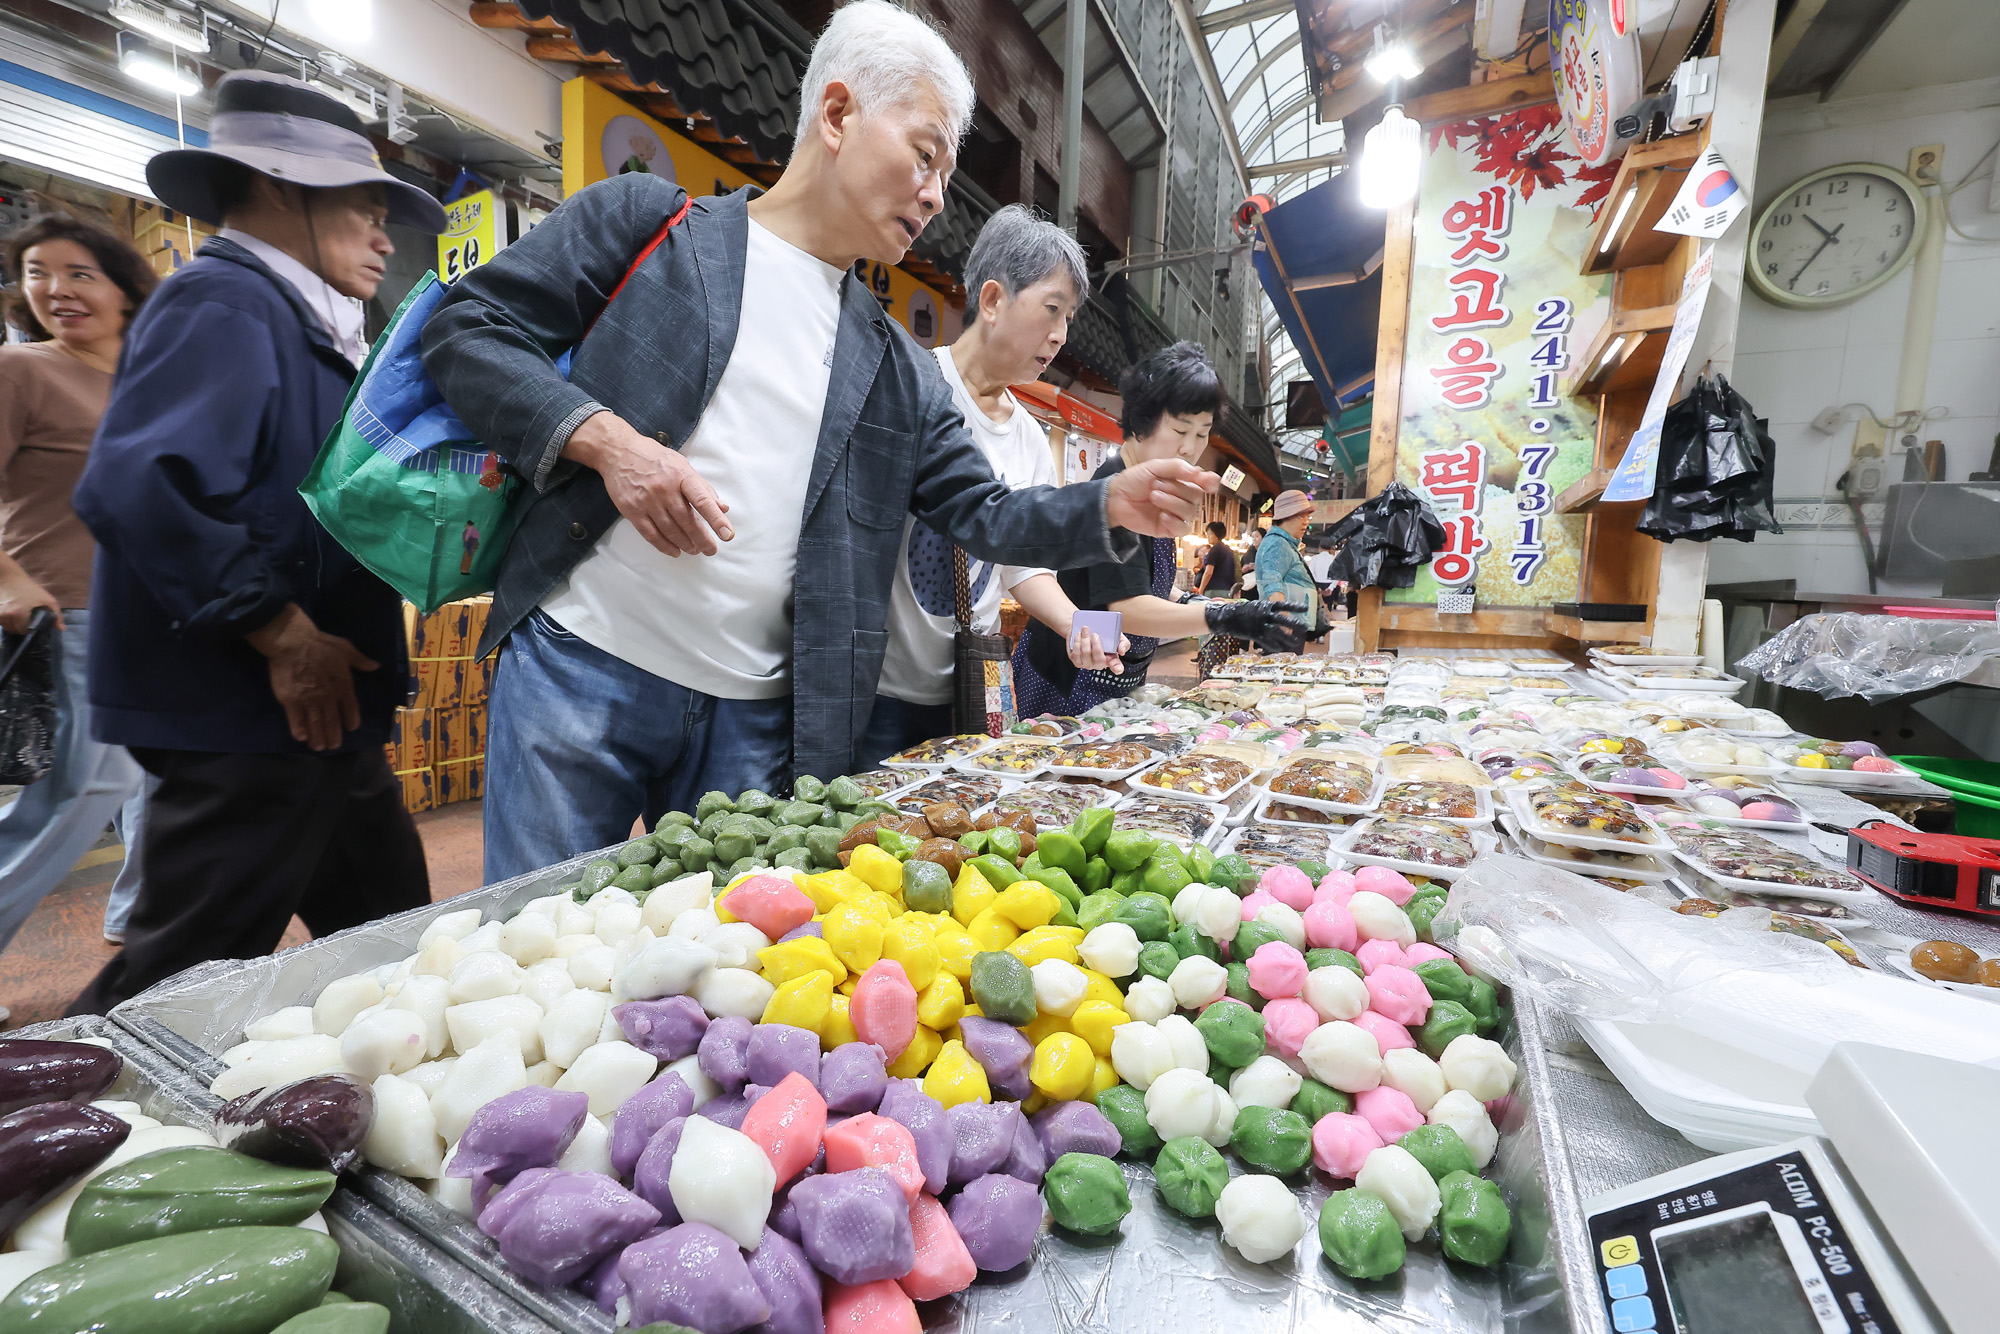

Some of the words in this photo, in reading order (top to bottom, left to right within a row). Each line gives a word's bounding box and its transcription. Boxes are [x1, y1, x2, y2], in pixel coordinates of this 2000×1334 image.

[1827, 180, 1849, 195] 12
[1863, 184, 1871, 198] 1
[1794, 193, 1812, 208] 11
[1885, 198, 1897, 212] 2
[1772, 213, 1792, 228] 10
[1889, 224, 1901, 238] 3
[1761, 240, 1774, 253] 9
[1876, 250, 1888, 264] 4
[1766, 262, 1778, 275] 8
[1430, 186, 1507, 405] 옛고을
[1422, 445, 1483, 581] 떡방
[1686, 1194, 1702, 1210] 용기
[1701, 1190, 1718, 1207] 영점
[1657, 1202, 1671, 1220] Batt
[1776, 1162, 1819, 1210] ACOM
[1805, 1215, 1854, 1276] PC-500
